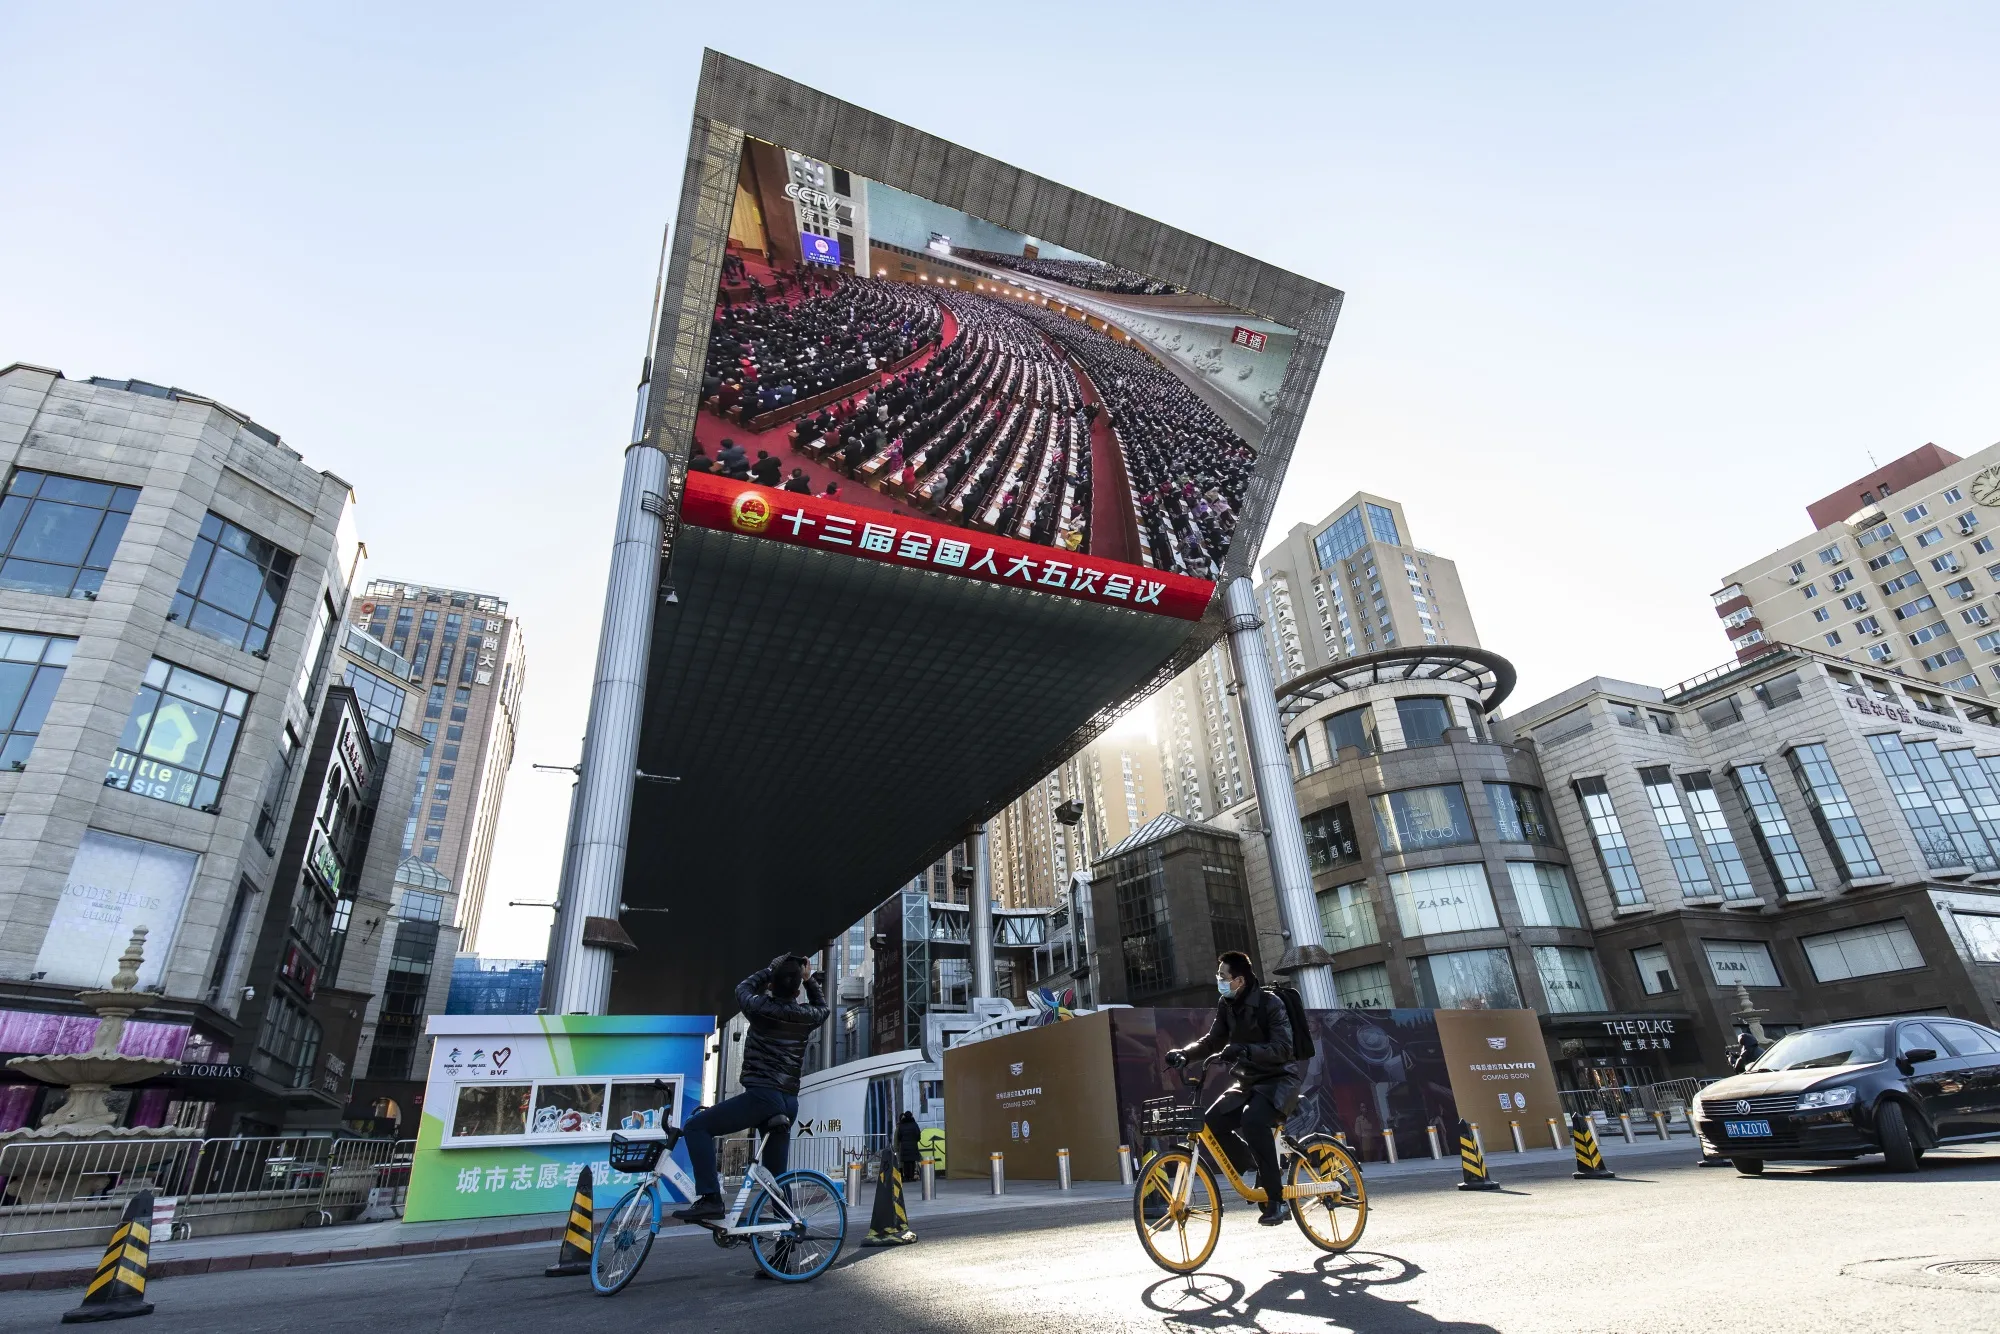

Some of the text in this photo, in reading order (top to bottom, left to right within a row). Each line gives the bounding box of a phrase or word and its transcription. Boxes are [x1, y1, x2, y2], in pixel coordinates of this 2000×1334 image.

[785, 183, 839, 210] CCTV
[801, 207, 841, 230] 综合
[1236, 329, 1263, 349] 直播
[781, 508, 1167, 606] 十三届全国人大五次会议
[475, 619, 503, 686] 时尚大厦
[1416, 895, 1464, 910] ZARA
[1715, 961, 1748, 971] ZARA
[1547, 980, 1581, 991] ZARA
[1346, 997, 1382, 1009] ZARA
[1602, 1020, 1676, 1036] THE PLACE
[163, 1064, 242, 1078] ICTORIA'S
[1482, 1073, 1509, 1081] COMING
[1002, 1099, 1036, 1109] COMING SOON
[816, 1119, 842, 1133] 小鹏
